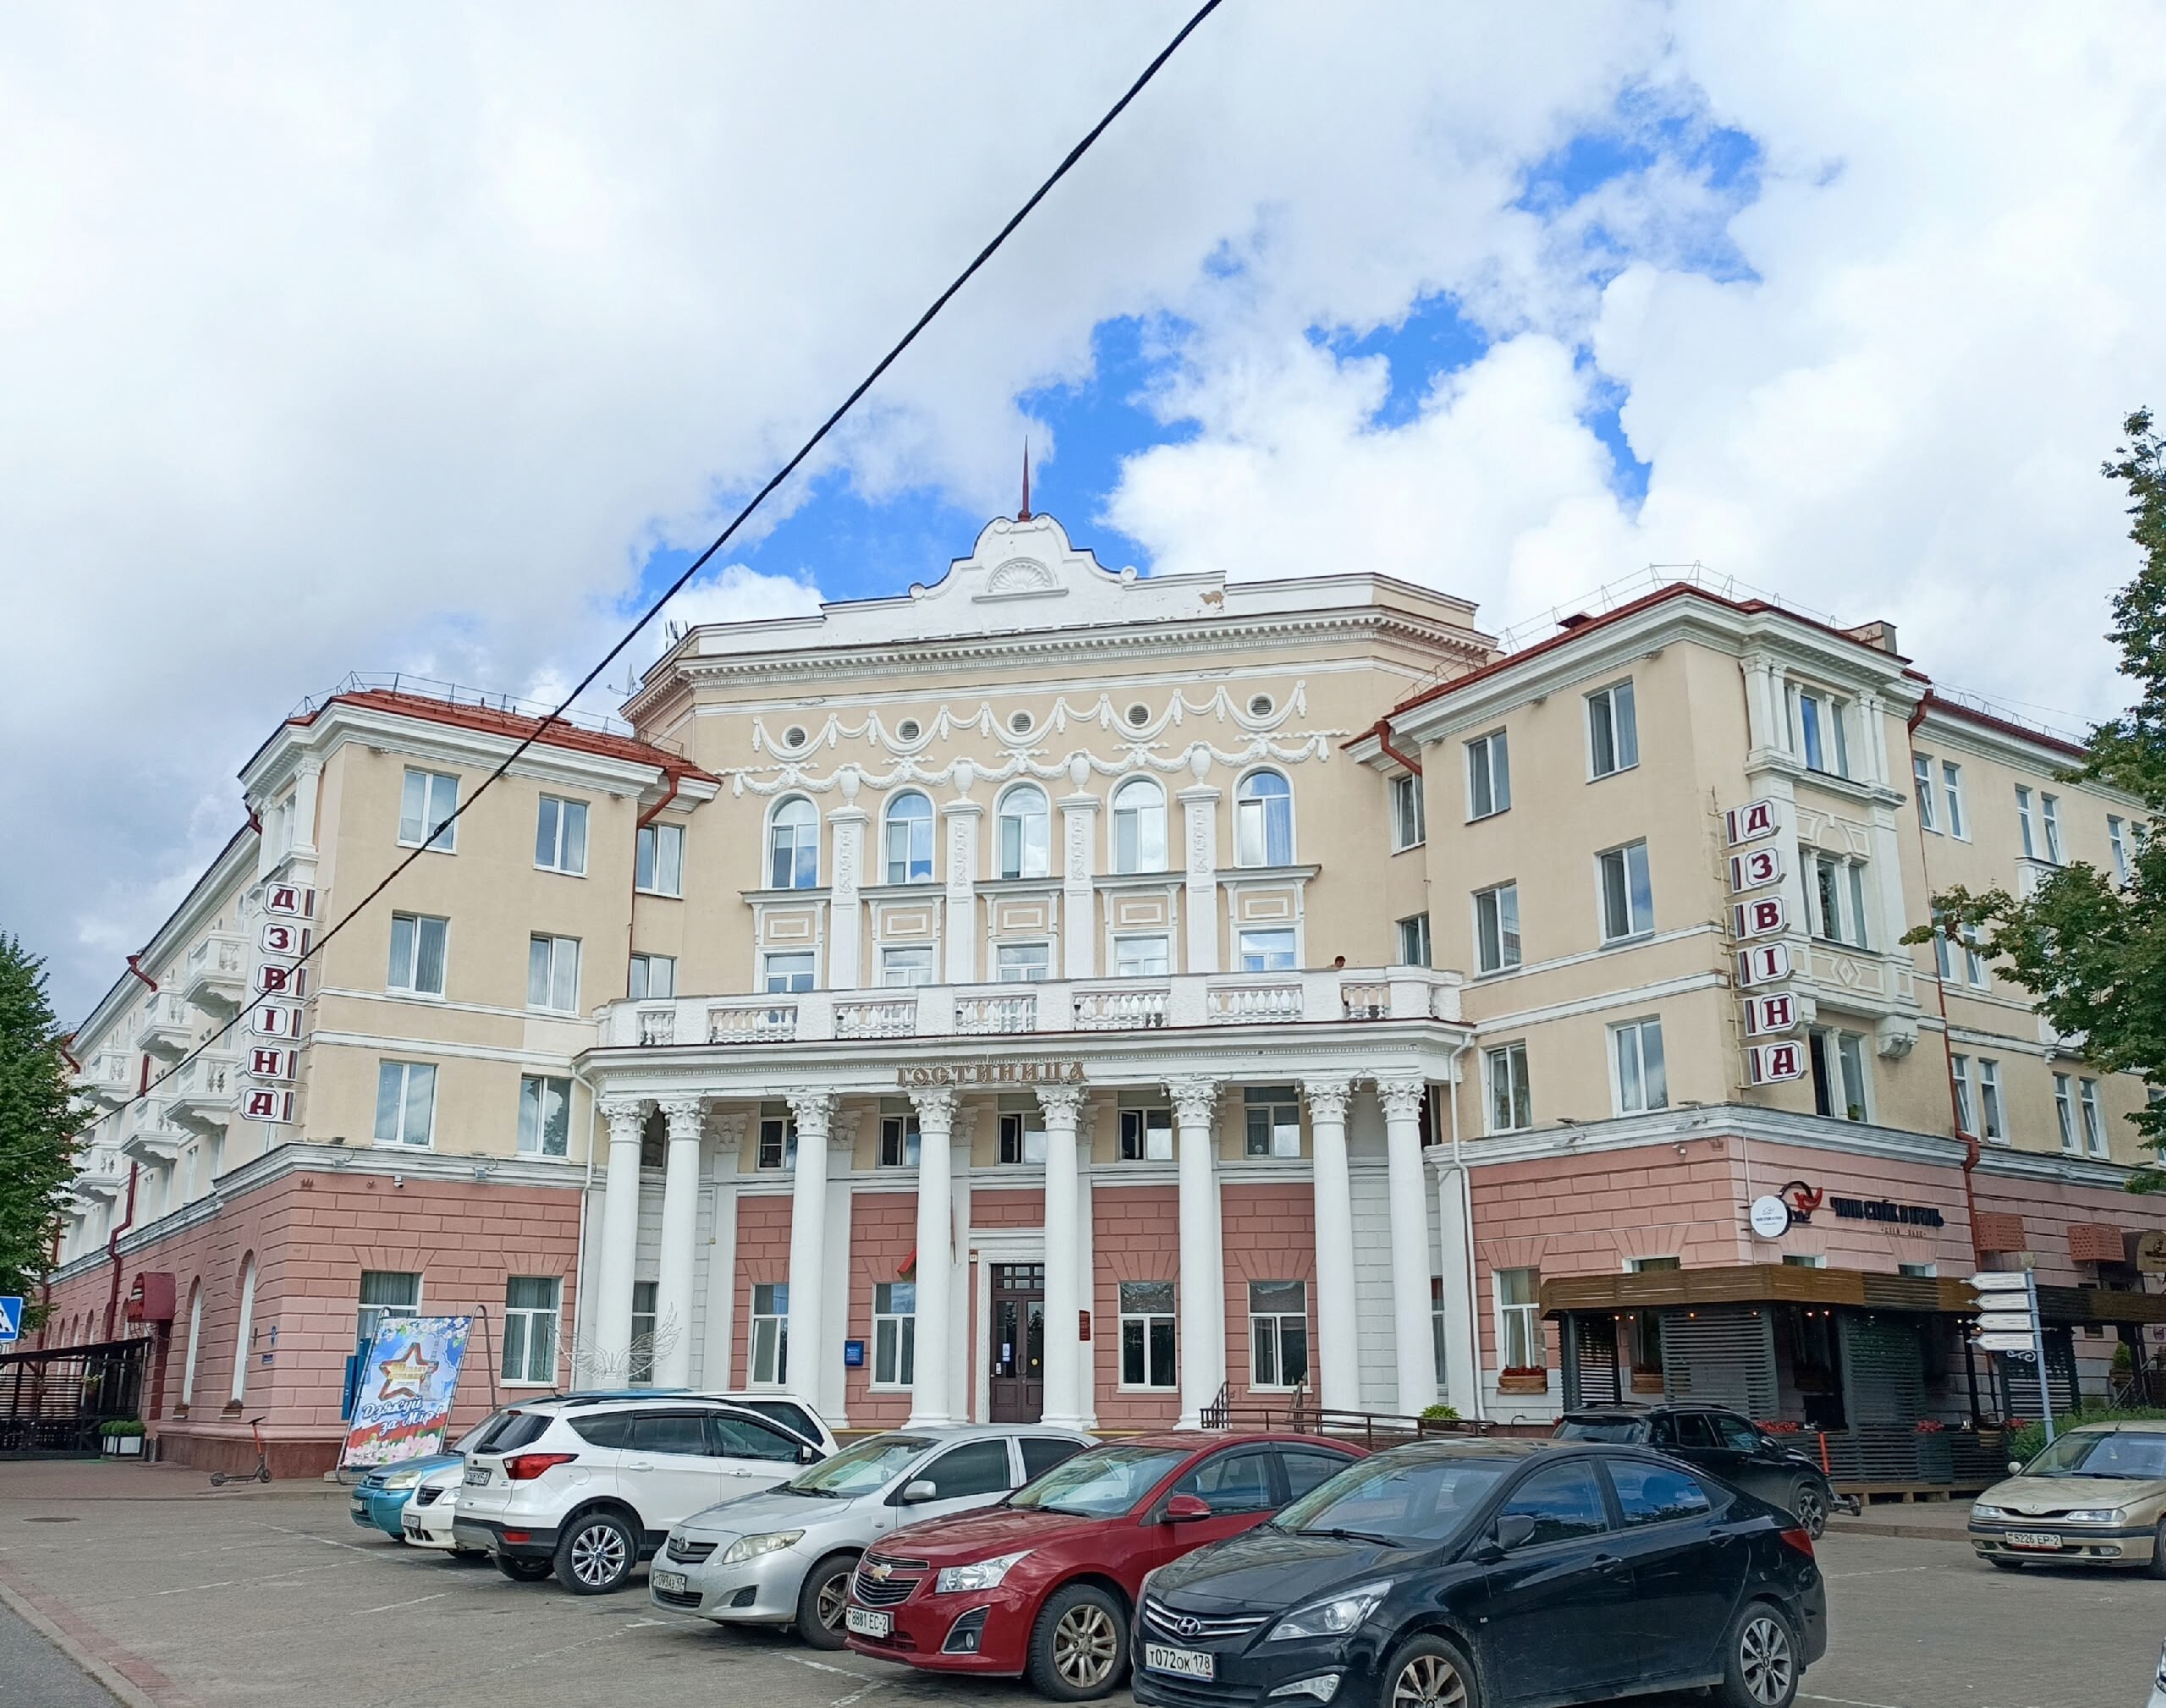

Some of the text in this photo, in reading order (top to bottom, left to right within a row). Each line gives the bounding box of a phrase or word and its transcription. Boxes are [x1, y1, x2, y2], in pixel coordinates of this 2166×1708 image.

[1747, 805, 1797, 1075] ДЗВІНА
[248, 888, 294, 1116] ДЗВІНА
[896, 1062, 1087, 1086] ГОСТИНИЦА
[362, 1395, 422, 1421] Дзякуй
[378, 1406, 444, 1436] за Мір!
[2015, 1533, 2059, 1546] 5226 EP-2
[869, 1613, 887, 1632] EC-2
[1149, 1648, 1211, 1672] Т072ОК 178
